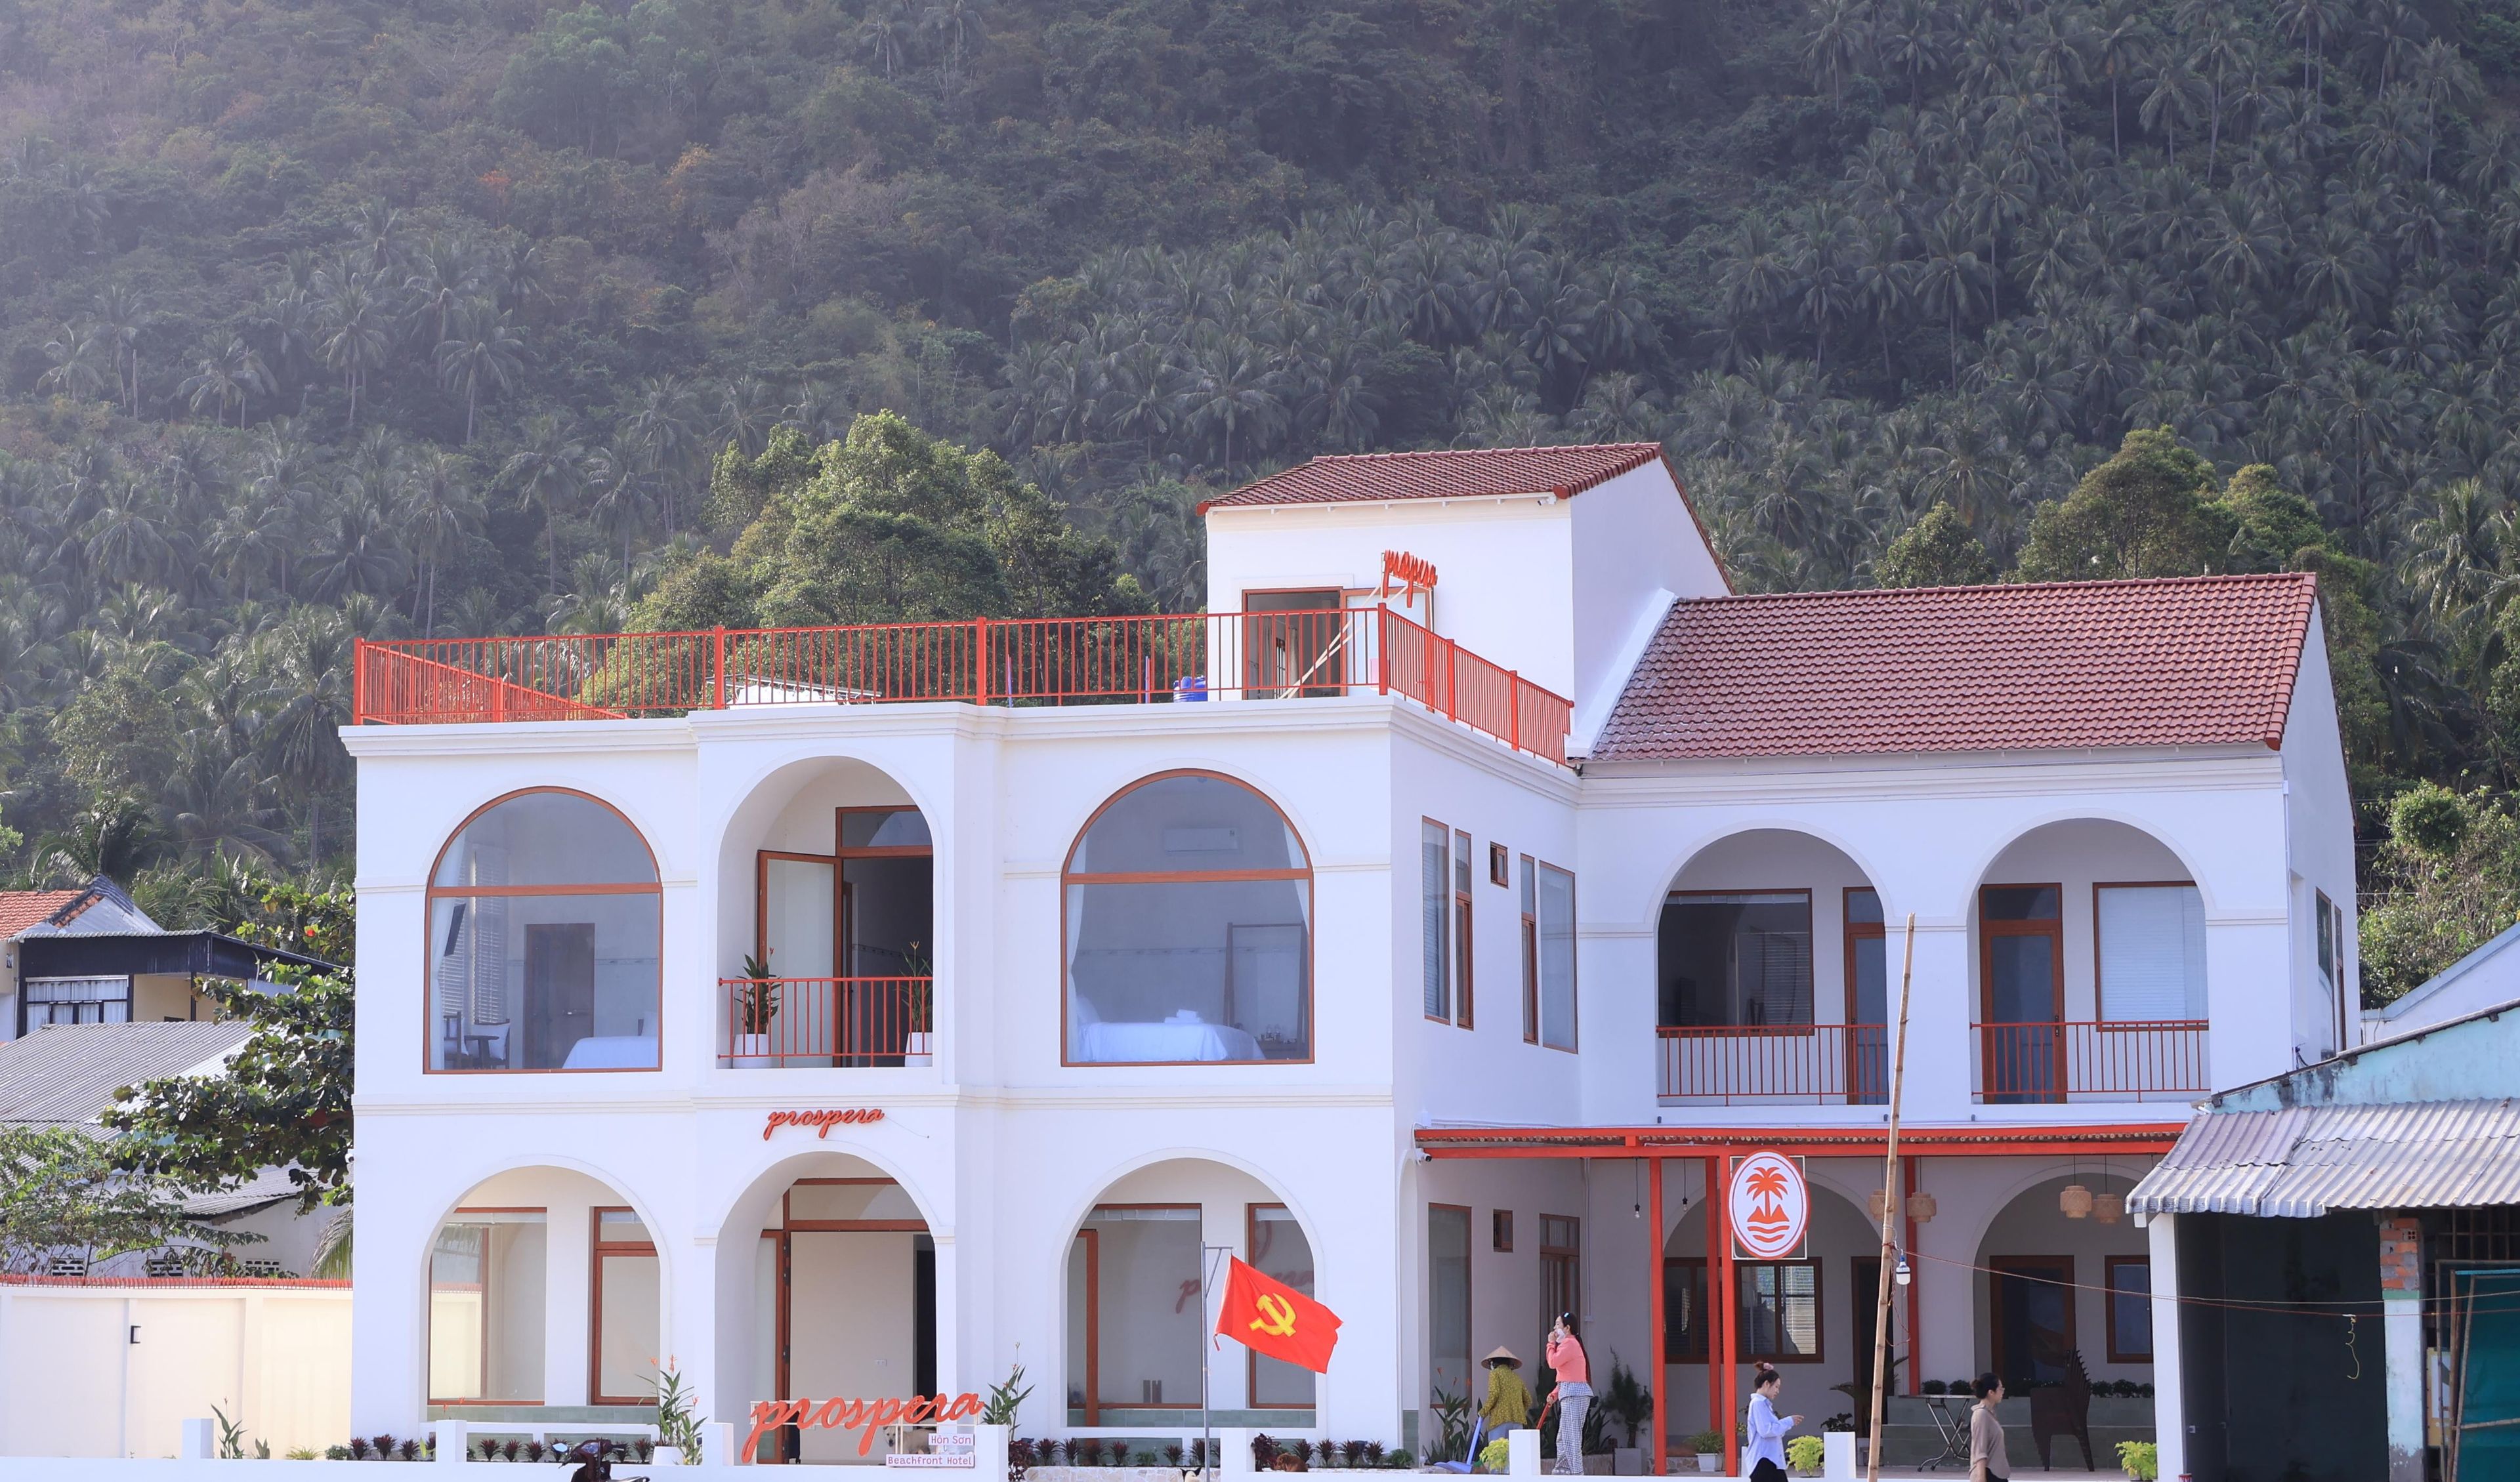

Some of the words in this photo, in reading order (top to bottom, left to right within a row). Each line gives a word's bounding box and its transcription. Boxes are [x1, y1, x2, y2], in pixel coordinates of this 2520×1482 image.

[763, 1108, 885, 1141] prospera
[741, 1392, 985, 1464] prospera
[887, 1456, 943, 1465] Beachfront
[947, 1456, 972, 1465] Hotel
